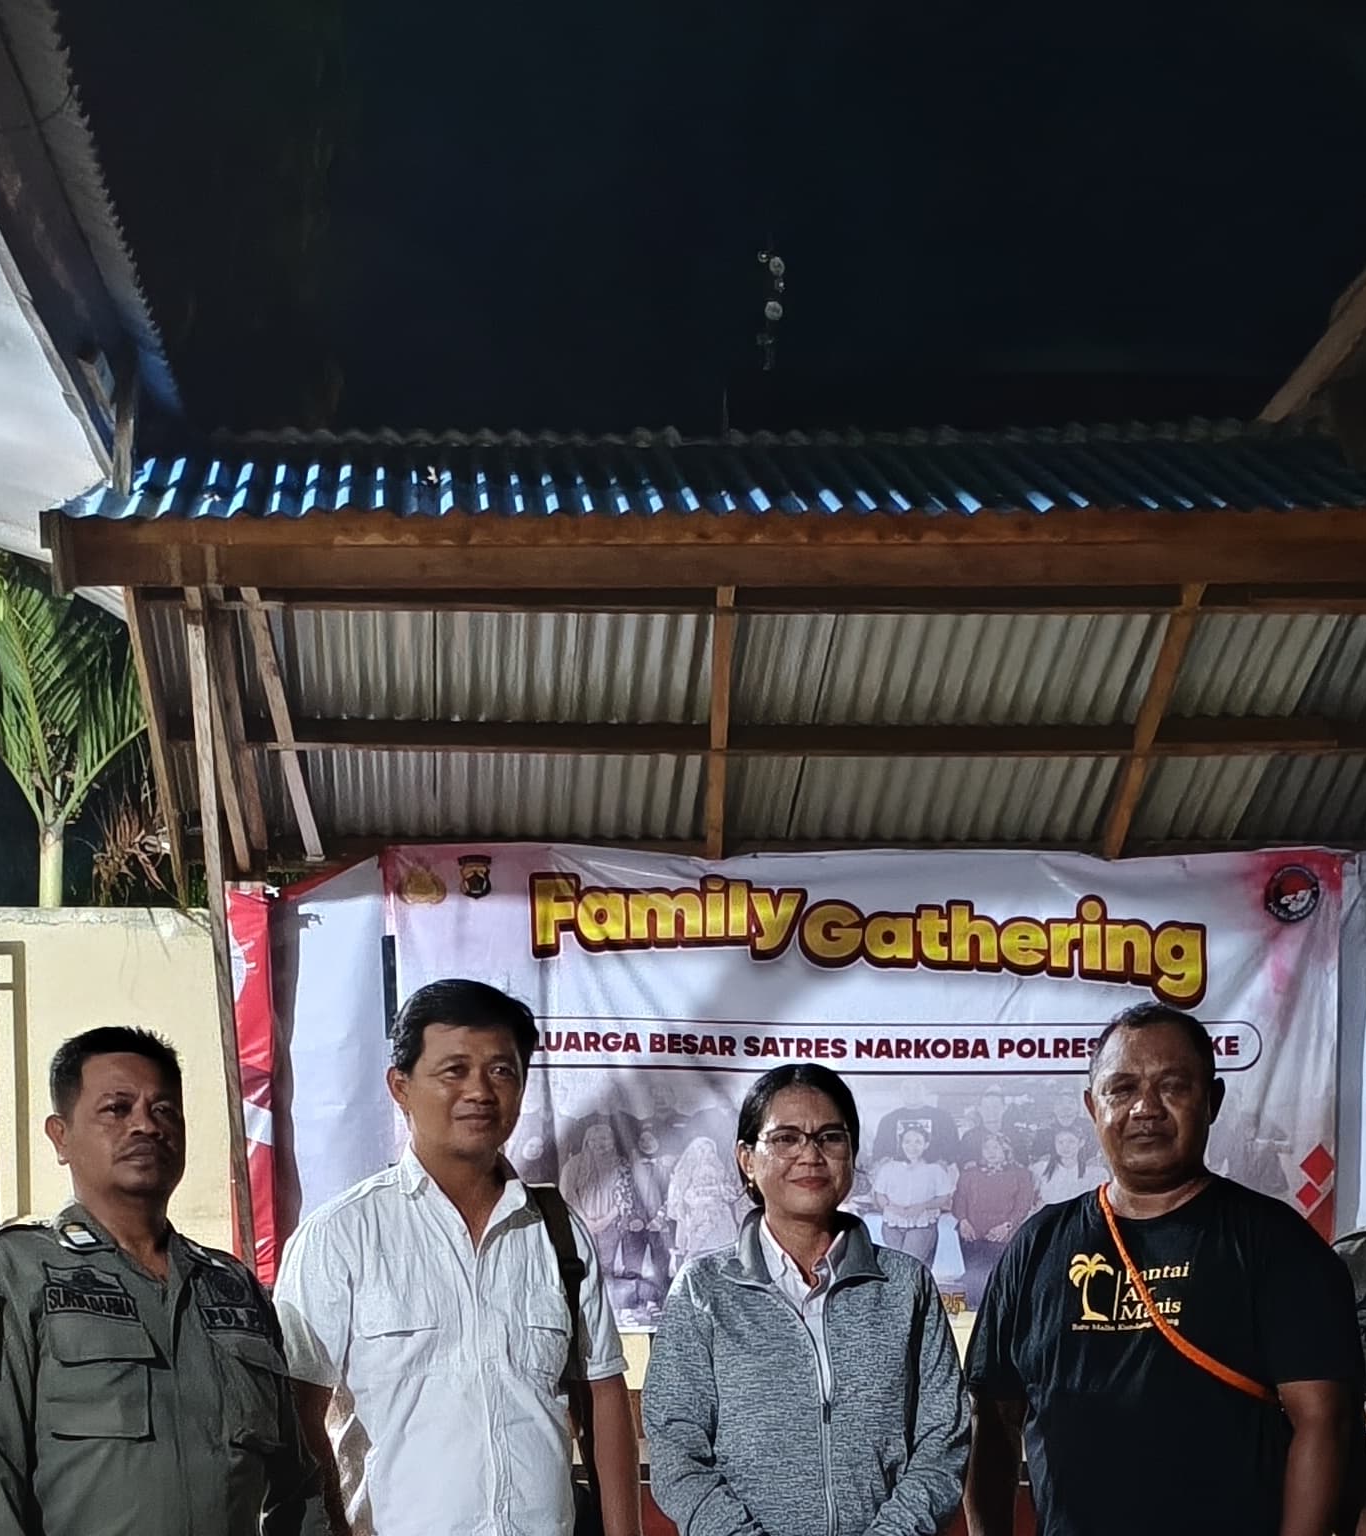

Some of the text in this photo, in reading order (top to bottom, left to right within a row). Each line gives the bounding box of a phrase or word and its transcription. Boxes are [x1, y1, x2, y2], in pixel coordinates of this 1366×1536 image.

[530, 873, 1209, 1009] Family Gathering
[532, 1031, 642, 1053] LUARGA
[649, 1033, 737, 1057] BESAR
[743, 1035, 848, 1059] SATRES
[855, 1037, 990, 1060] NARKOBA
[997, 1037, 1103, 1059] POLRES
